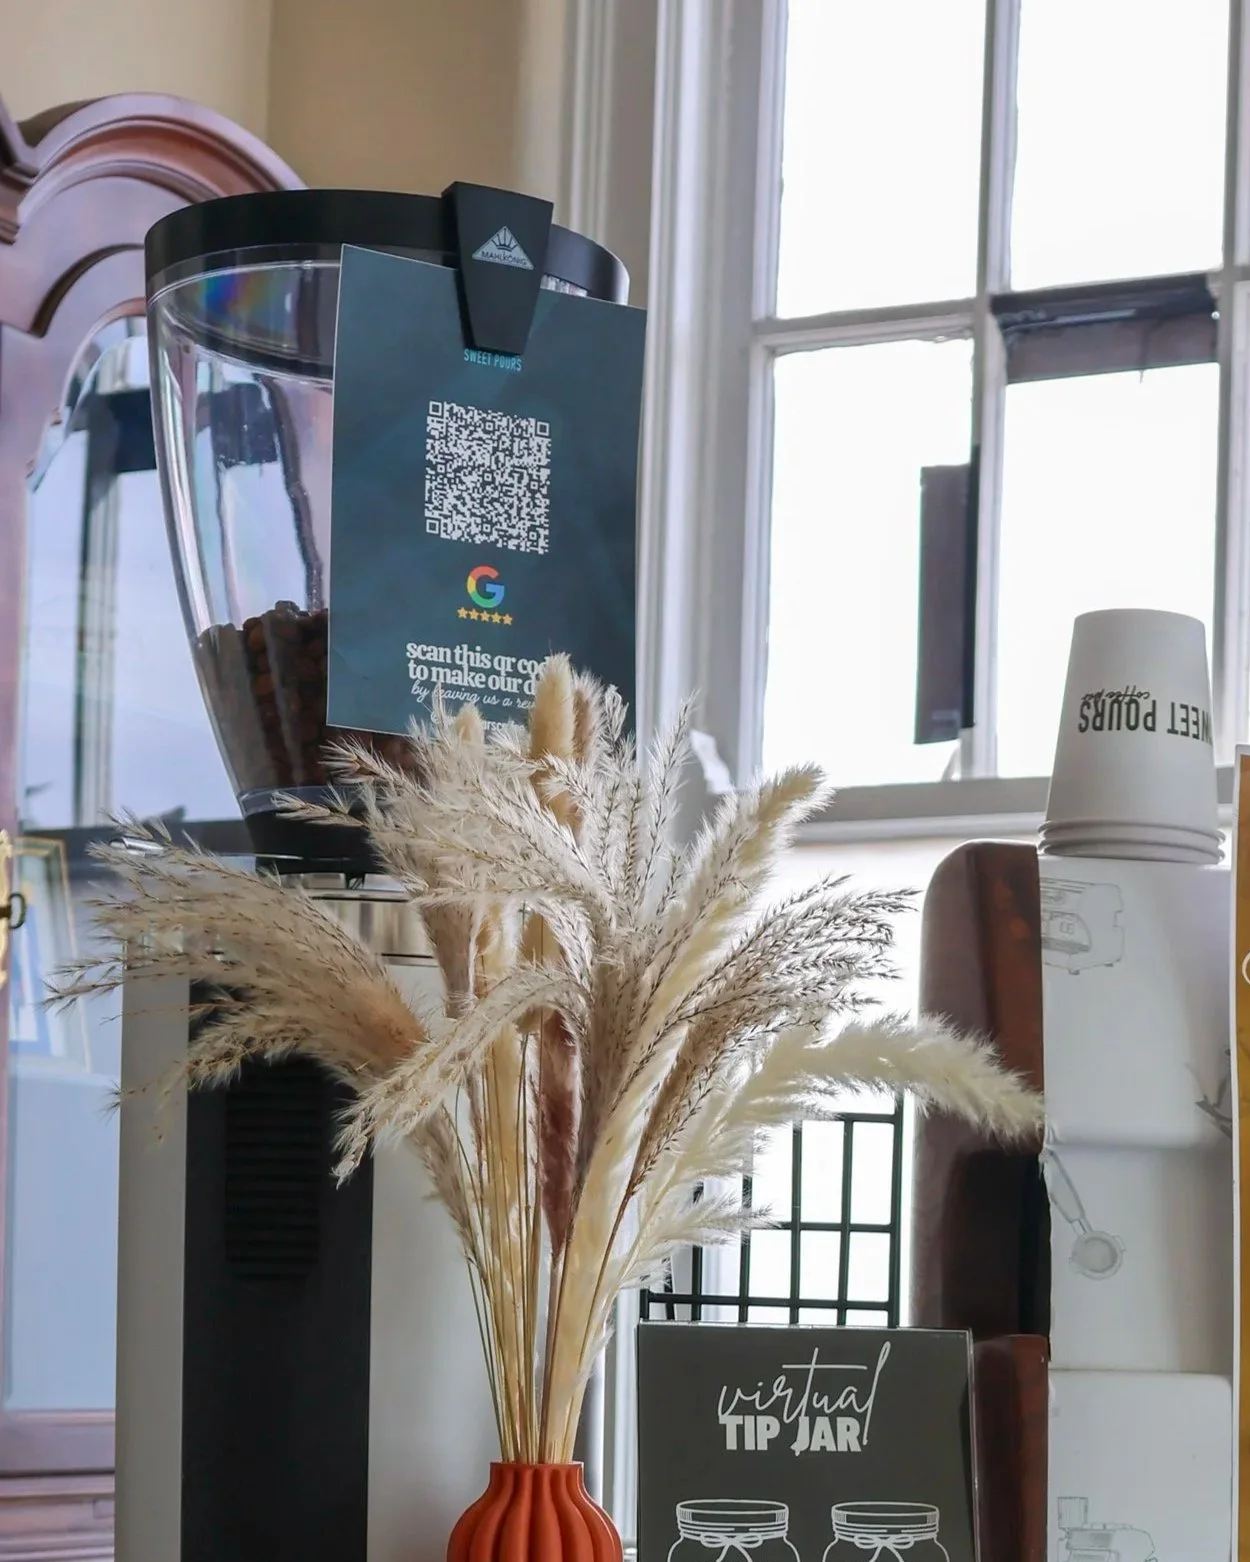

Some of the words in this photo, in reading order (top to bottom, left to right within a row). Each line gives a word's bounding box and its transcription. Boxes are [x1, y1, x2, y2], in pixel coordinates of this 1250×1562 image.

[464, 348, 492, 365] SWEET
[494, 354, 522, 371] POURS
[406, 643, 451, 663] scan
[453, 644, 491, 669] this
[493, 655, 516, 677] qr
[408, 660, 429, 680] to
[431, 664, 486, 688] make
[488, 675, 522, 693] our
[411, 680, 430, 703] by
[483, 695, 500, 705] us
[502, 698, 513, 706] a
[1106, 685, 1150, 701] coffee
[1078, 699, 1156, 733] POURS
[1167, 702, 1212, 745] WEET
[718, 1340, 891, 1456] virtual
[719, 1415, 780, 1450] TIP
[791, 1416, 861, 1452] JAR
